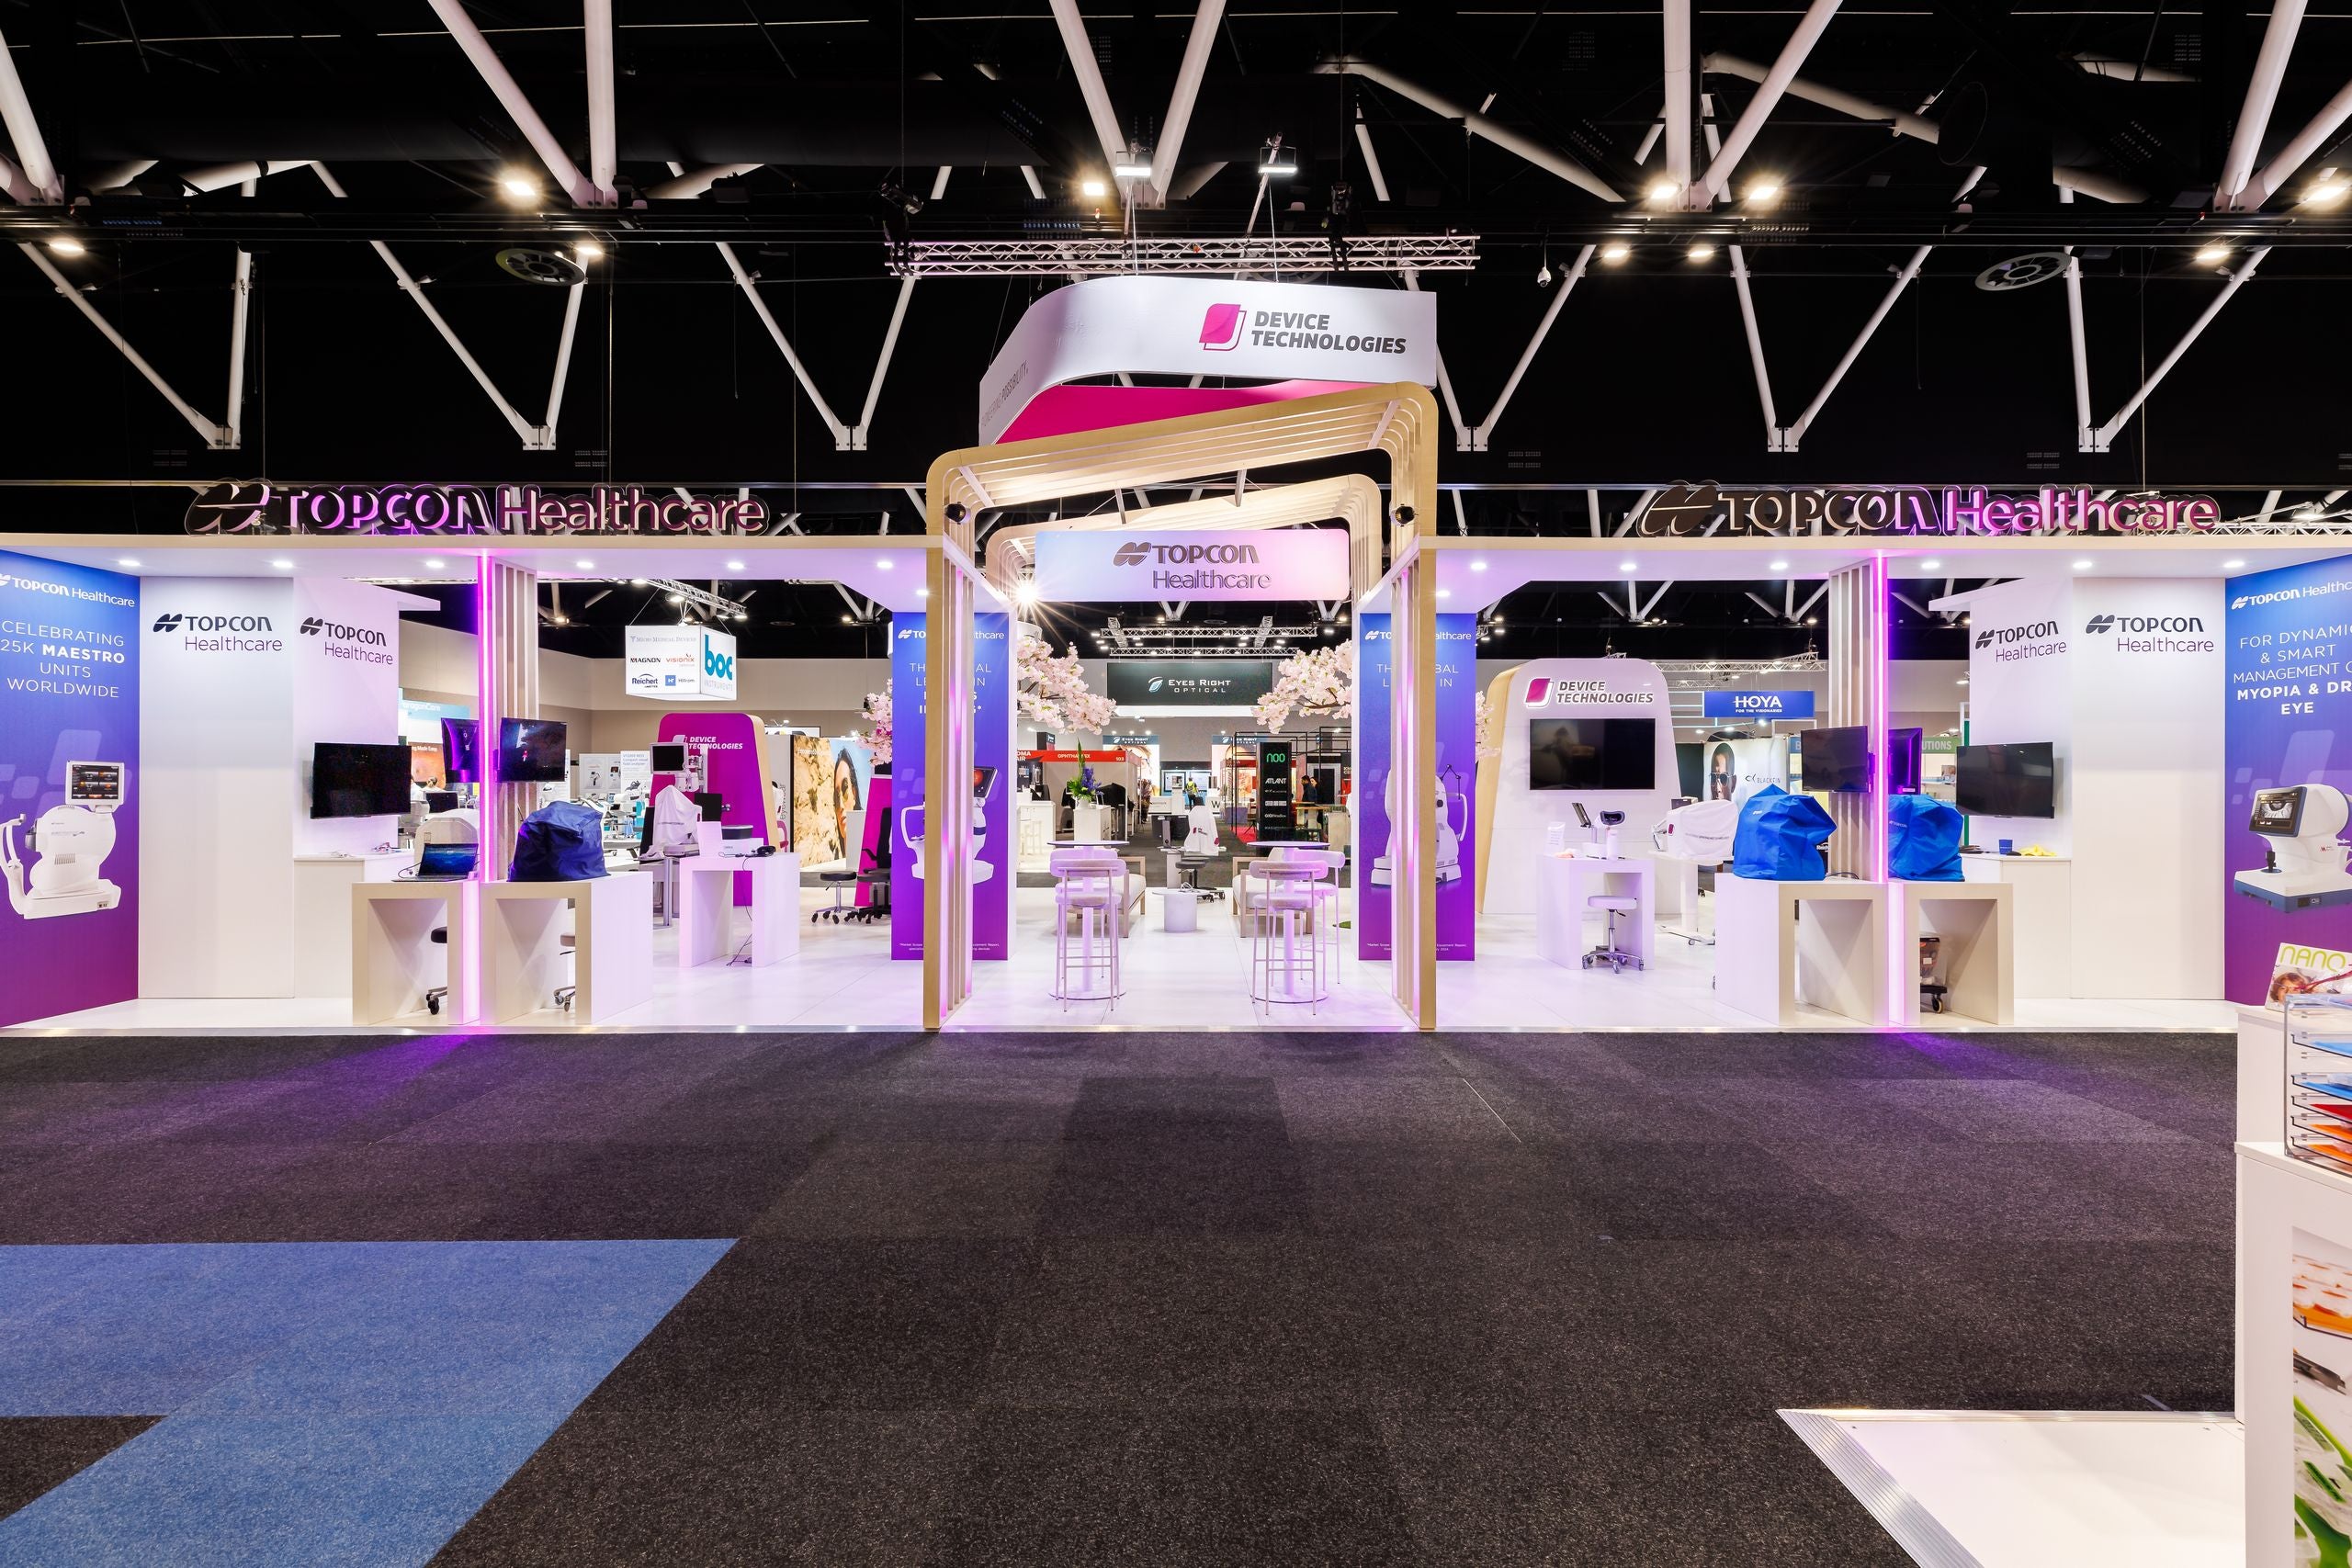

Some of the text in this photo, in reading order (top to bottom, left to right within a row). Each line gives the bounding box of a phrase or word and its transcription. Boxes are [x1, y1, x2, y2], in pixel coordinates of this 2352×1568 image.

[1254, 310, 1329, 331] DEVICE
[1251, 331, 1407, 355] TECHNOLOGIES
[270, 487, 764, 531] TOPCON Healthcare
[1718, 489, 2219, 531] TOPCON Healthcare
[1152, 544, 1259, 564] TOPCON
[1152, 569, 1272, 590] Healthcare
[12, 577, 135, 607] TOPCON Healthcare
[2249, 581, 2352, 606] TOPCON Healthc
[2, 620, 124, 647] CELEBRATING
[186, 616, 273, 632] TOPCON
[1996, 621, 2059, 641] TOPCON
[2117, 617, 2204, 633] TOPCON
[185, 636, 283, 652] Healthcare
[324, 622, 387, 647] TOPCON
[1435, 631, 1472, 640] althcare
[2240, 624, 2352, 649] FOR DYNAMI
[0, 639, 125, 663] 25K MAESTRO
[324, 641, 393, 665] Healthcare
[1996, 640, 2067, 662] Healthcare
[2117, 637, 2214, 653] Healthcare
[2260, 645, 2336, 664] & SMART
[705, 634, 732, 681] boc
[40, 662, 91, 678] UNITS
[2233, 662, 2340, 683] MANAGEMENT
[7, 678, 119, 698] WORLDWIDE
[1440, 678, 1453, 687] IN
[1559, 682, 1606, 691] DEVICE
[2237, 681, 2352, 701] MYOPIA & DR
[1557, 694, 1654, 704] TECHNOLOGIES
[1735, 695, 1782, 708] HOYA
[2281, 702, 2314, 715] EYE
[1922, 740, 1952, 750] UTIONS
